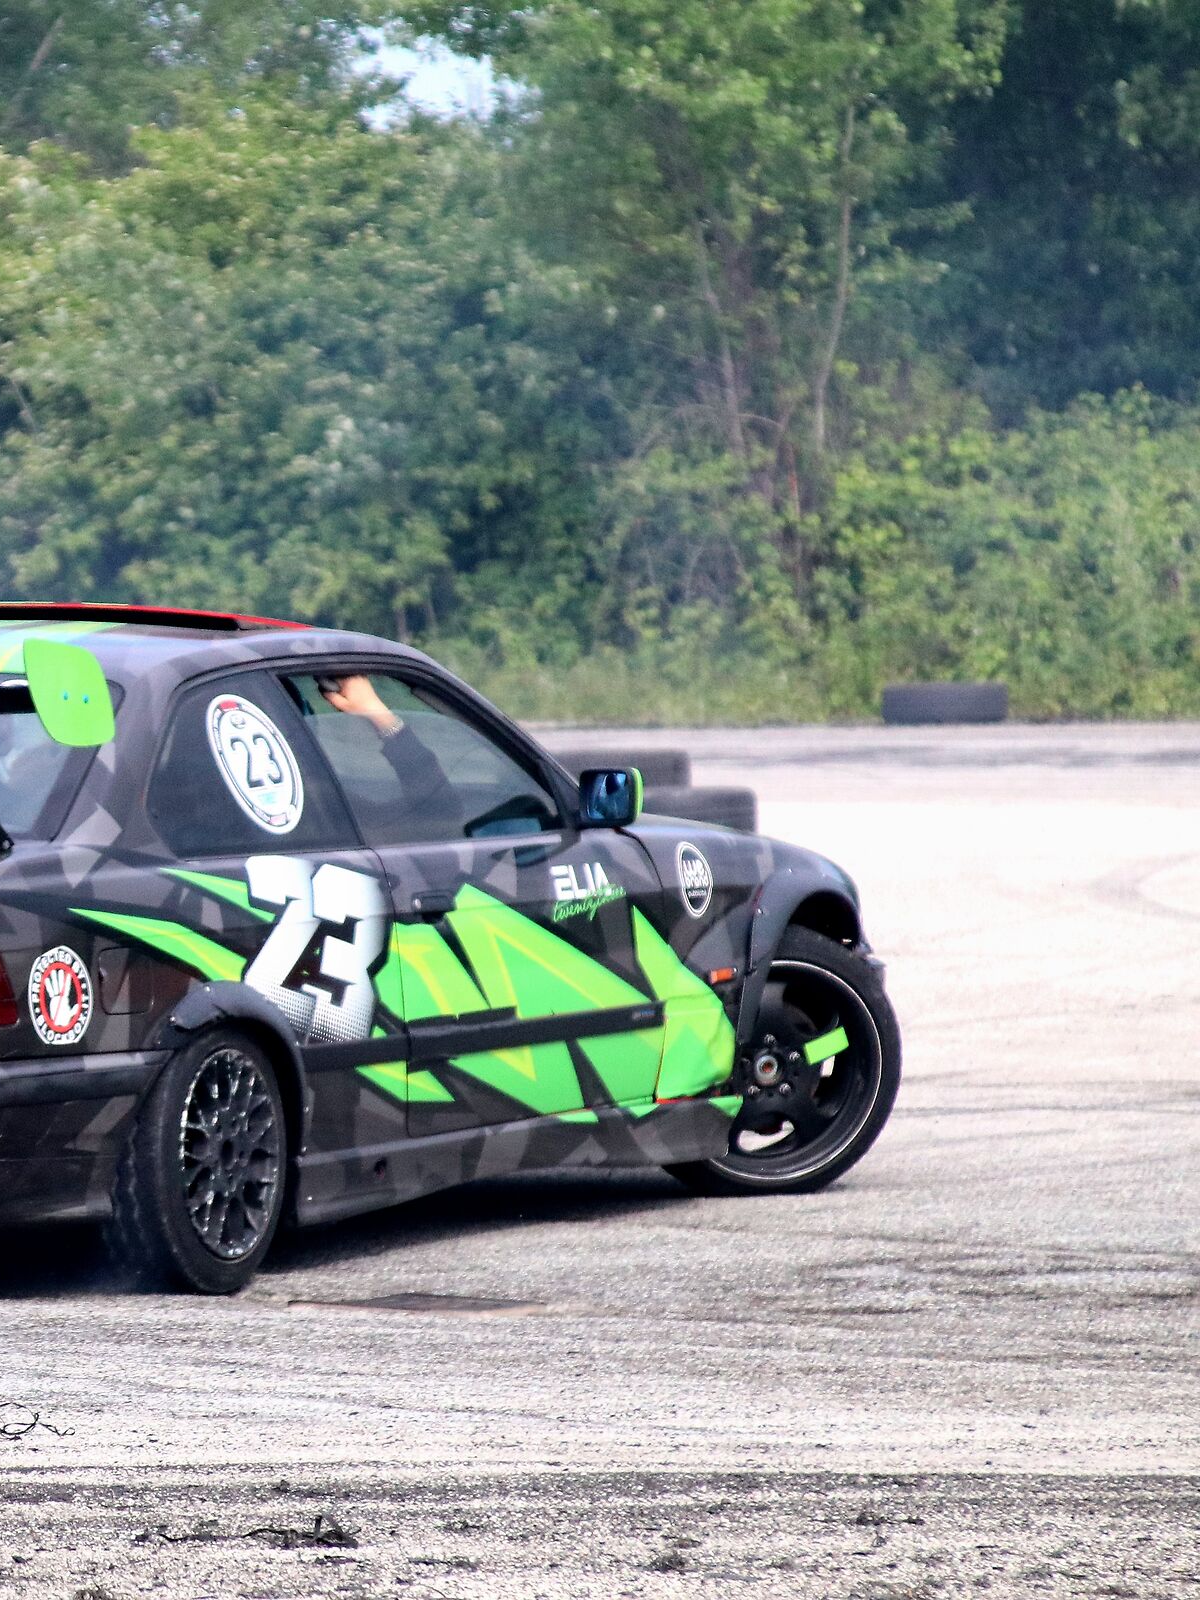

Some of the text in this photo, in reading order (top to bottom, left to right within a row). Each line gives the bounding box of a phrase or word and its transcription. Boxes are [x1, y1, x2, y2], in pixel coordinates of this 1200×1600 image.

[230, 733, 284, 788] 23
[550, 862, 612, 901] ELIA
[683, 870, 708, 889] brand
[31, 950, 72, 1003] PROTECTED
